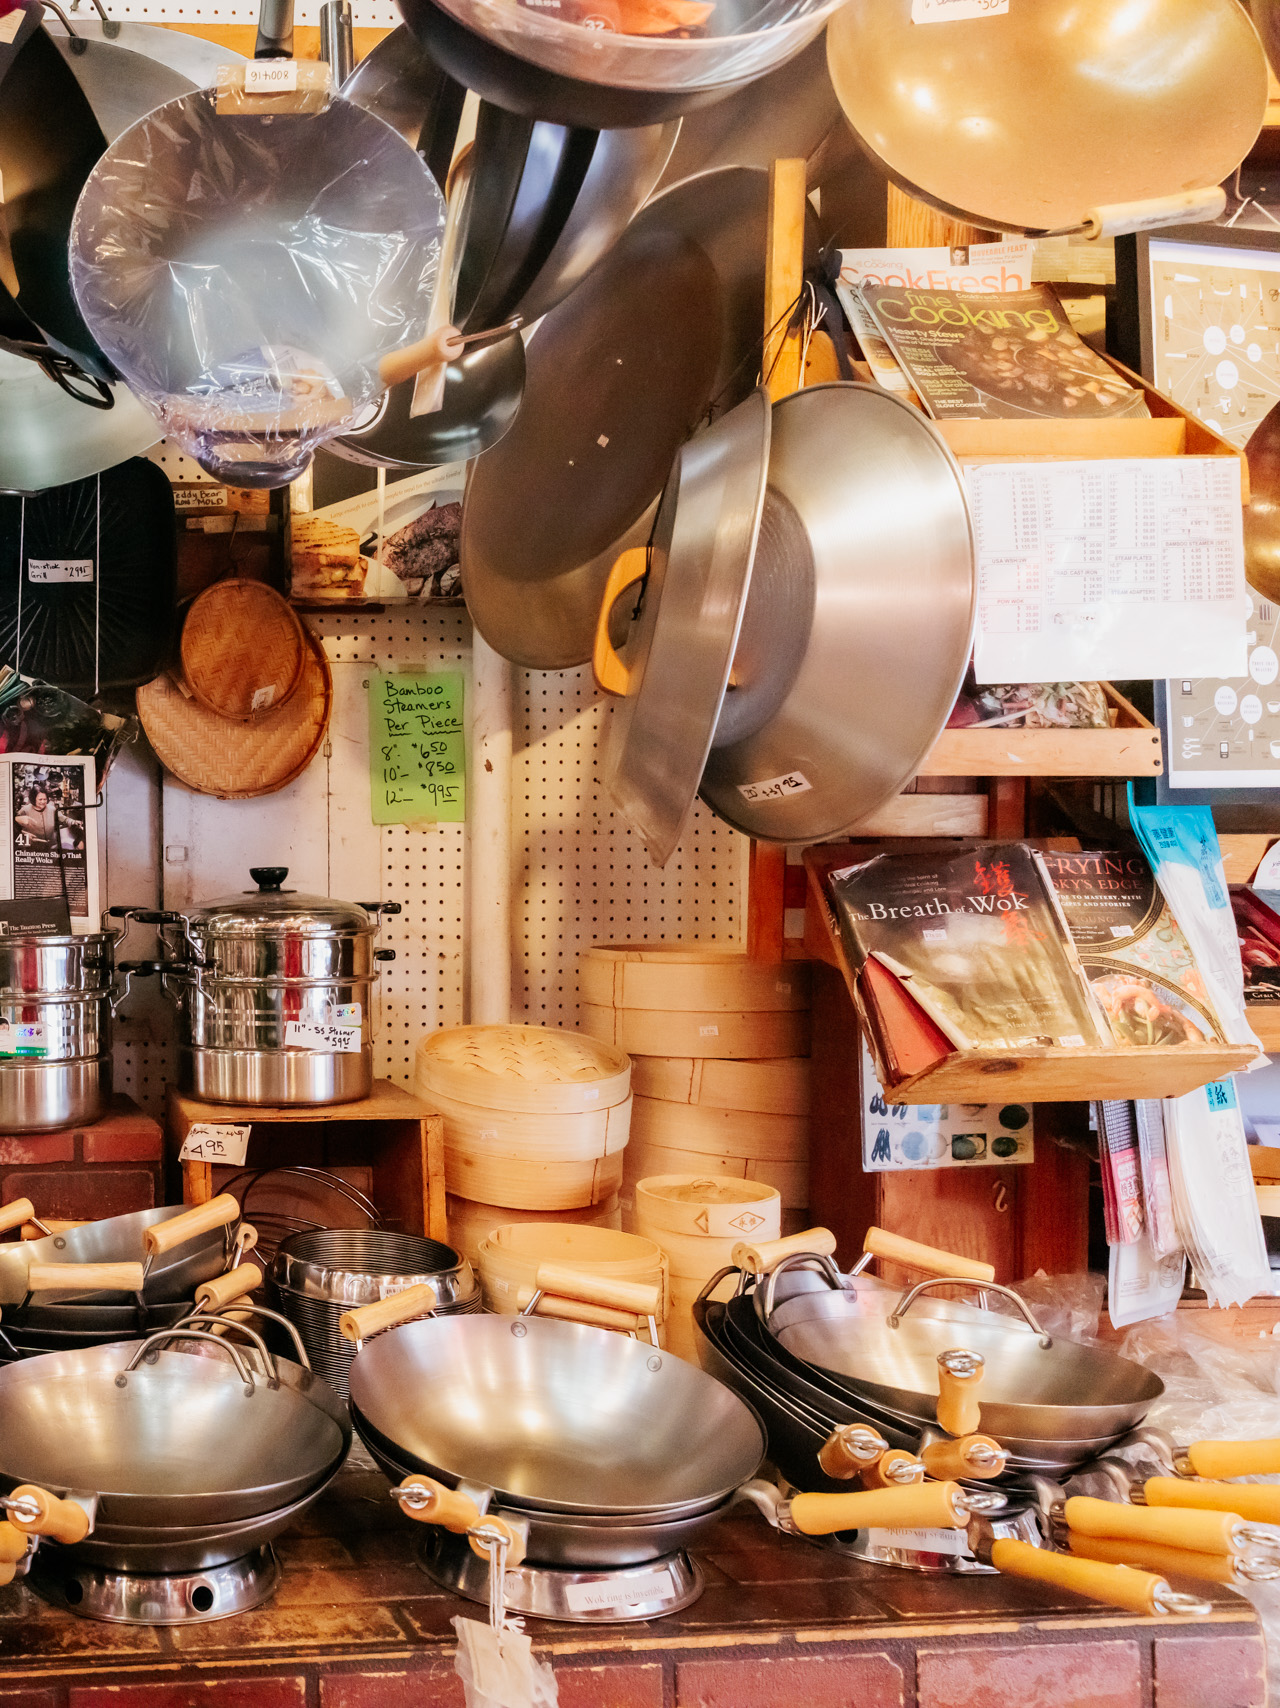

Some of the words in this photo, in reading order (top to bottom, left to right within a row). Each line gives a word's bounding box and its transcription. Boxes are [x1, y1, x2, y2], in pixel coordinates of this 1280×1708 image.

[905, 291, 953, 307] fine
[876, 299, 1059, 333] Cooking
[928, 330, 965, 338] Stews
[384, 680, 444, 697] Bamboo
[383, 698, 452, 714] Steamers
[384, 718, 409, 731] Per
[416, 715, 463, 729] Piece
[15, 833, 31, 846] 41
[15, 856, 35, 864] Really
[1098, 879, 1143, 889] EDGE
[849, 912, 869, 921] The
[867, 898, 952, 920] Breath
[955, 905, 966, 914] of
[966, 893, 1029, 914] Wok
[584, 1595, 605, 1604] Wok
[607, 1594, 622, 1603] ring
[632, 1586, 664, 1598] Invertible
